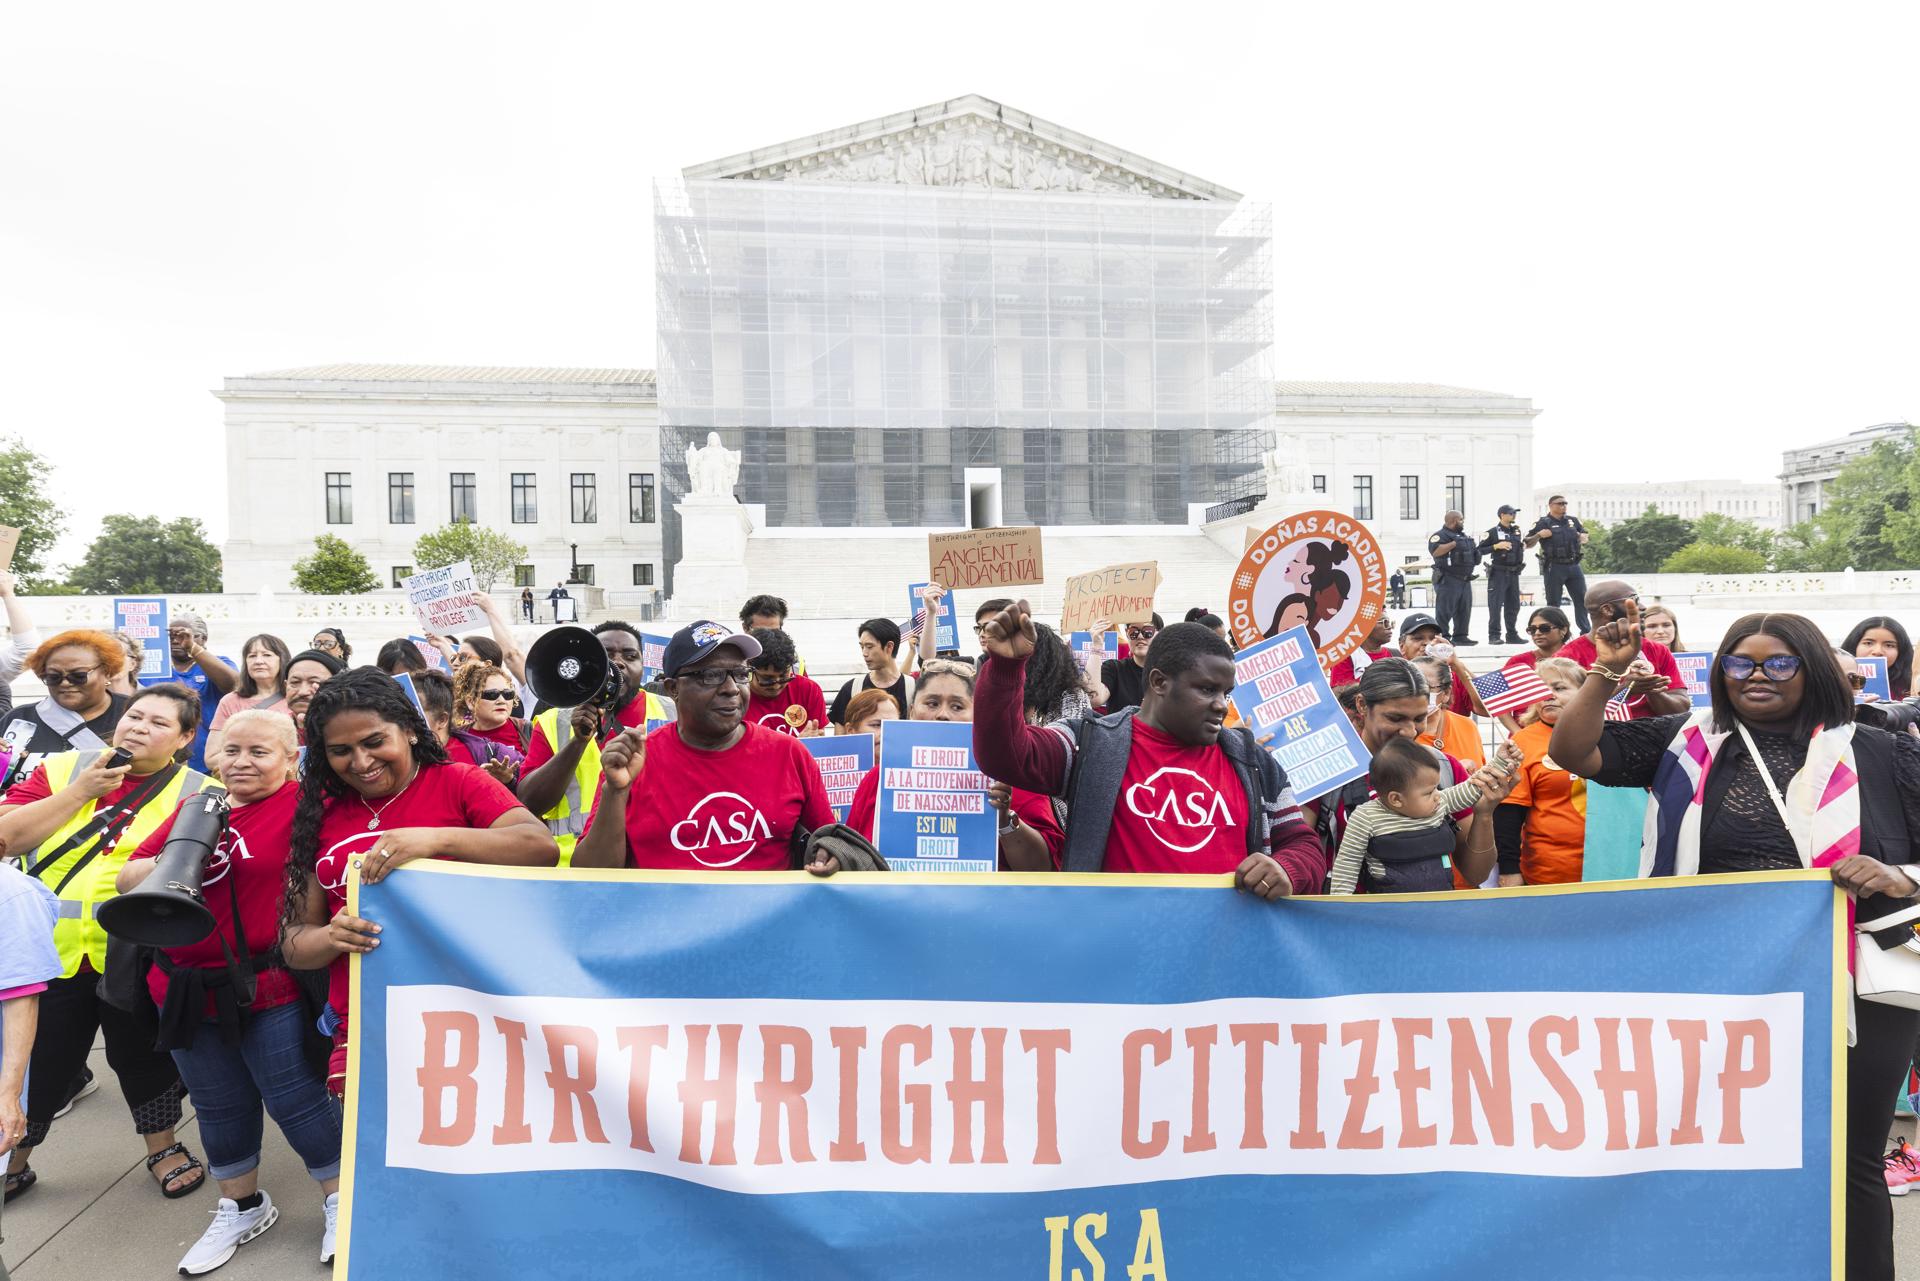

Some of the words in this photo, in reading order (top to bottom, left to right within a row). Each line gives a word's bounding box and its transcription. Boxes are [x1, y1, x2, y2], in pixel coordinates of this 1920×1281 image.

[935, 533, 977, 543] BIRTHRIGHT
[939, 543, 1018, 567] ANCIENT
[1250, 516, 1318, 565] DOÑAS
[1322, 517, 1382, 596] ACADEMY
[408, 567, 453, 589] BIRTHRIGHT
[933, 558, 1044, 587] FUNDAMENTAL
[1067, 567, 1150, 600] PROTECT
[410, 583, 450, 605] CITIZENSHIP
[1088, 593, 1153, 623] AMENDMENT
[418, 607, 426, 619] A
[429, 611, 468, 630] PRIVILEGE
[1235, 640, 1302, 684] AMERICAN
[1258, 669, 1296, 699] BORN
[1257, 685, 1317, 725] CHILDREN
[1283, 715, 1311, 740] ARE
[915, 749, 927, 766] LE
[931, 750, 966, 767] DROIT
[1275, 726, 1345, 770] AMERICAN
[887, 768, 896, 787] À
[899, 771, 913, 788] LA
[1289, 748, 1354, 792] CHILDREN
[896, 793, 911, 810] DE
[914, 794, 981, 811] NAISSANCE
[1126, 783, 1237, 828] CASA
[670, 809, 773, 851] CASA
[916, 815, 937, 833] EST
[940, 816, 957, 834] UN
[920, 839, 956, 856] DROIT
[417, 1010, 1071, 1166] BIRTHRIGHT
[1121, 1015, 1771, 1160] CITIZENSHIP
[1044, 1211, 1108, 1281] IS
